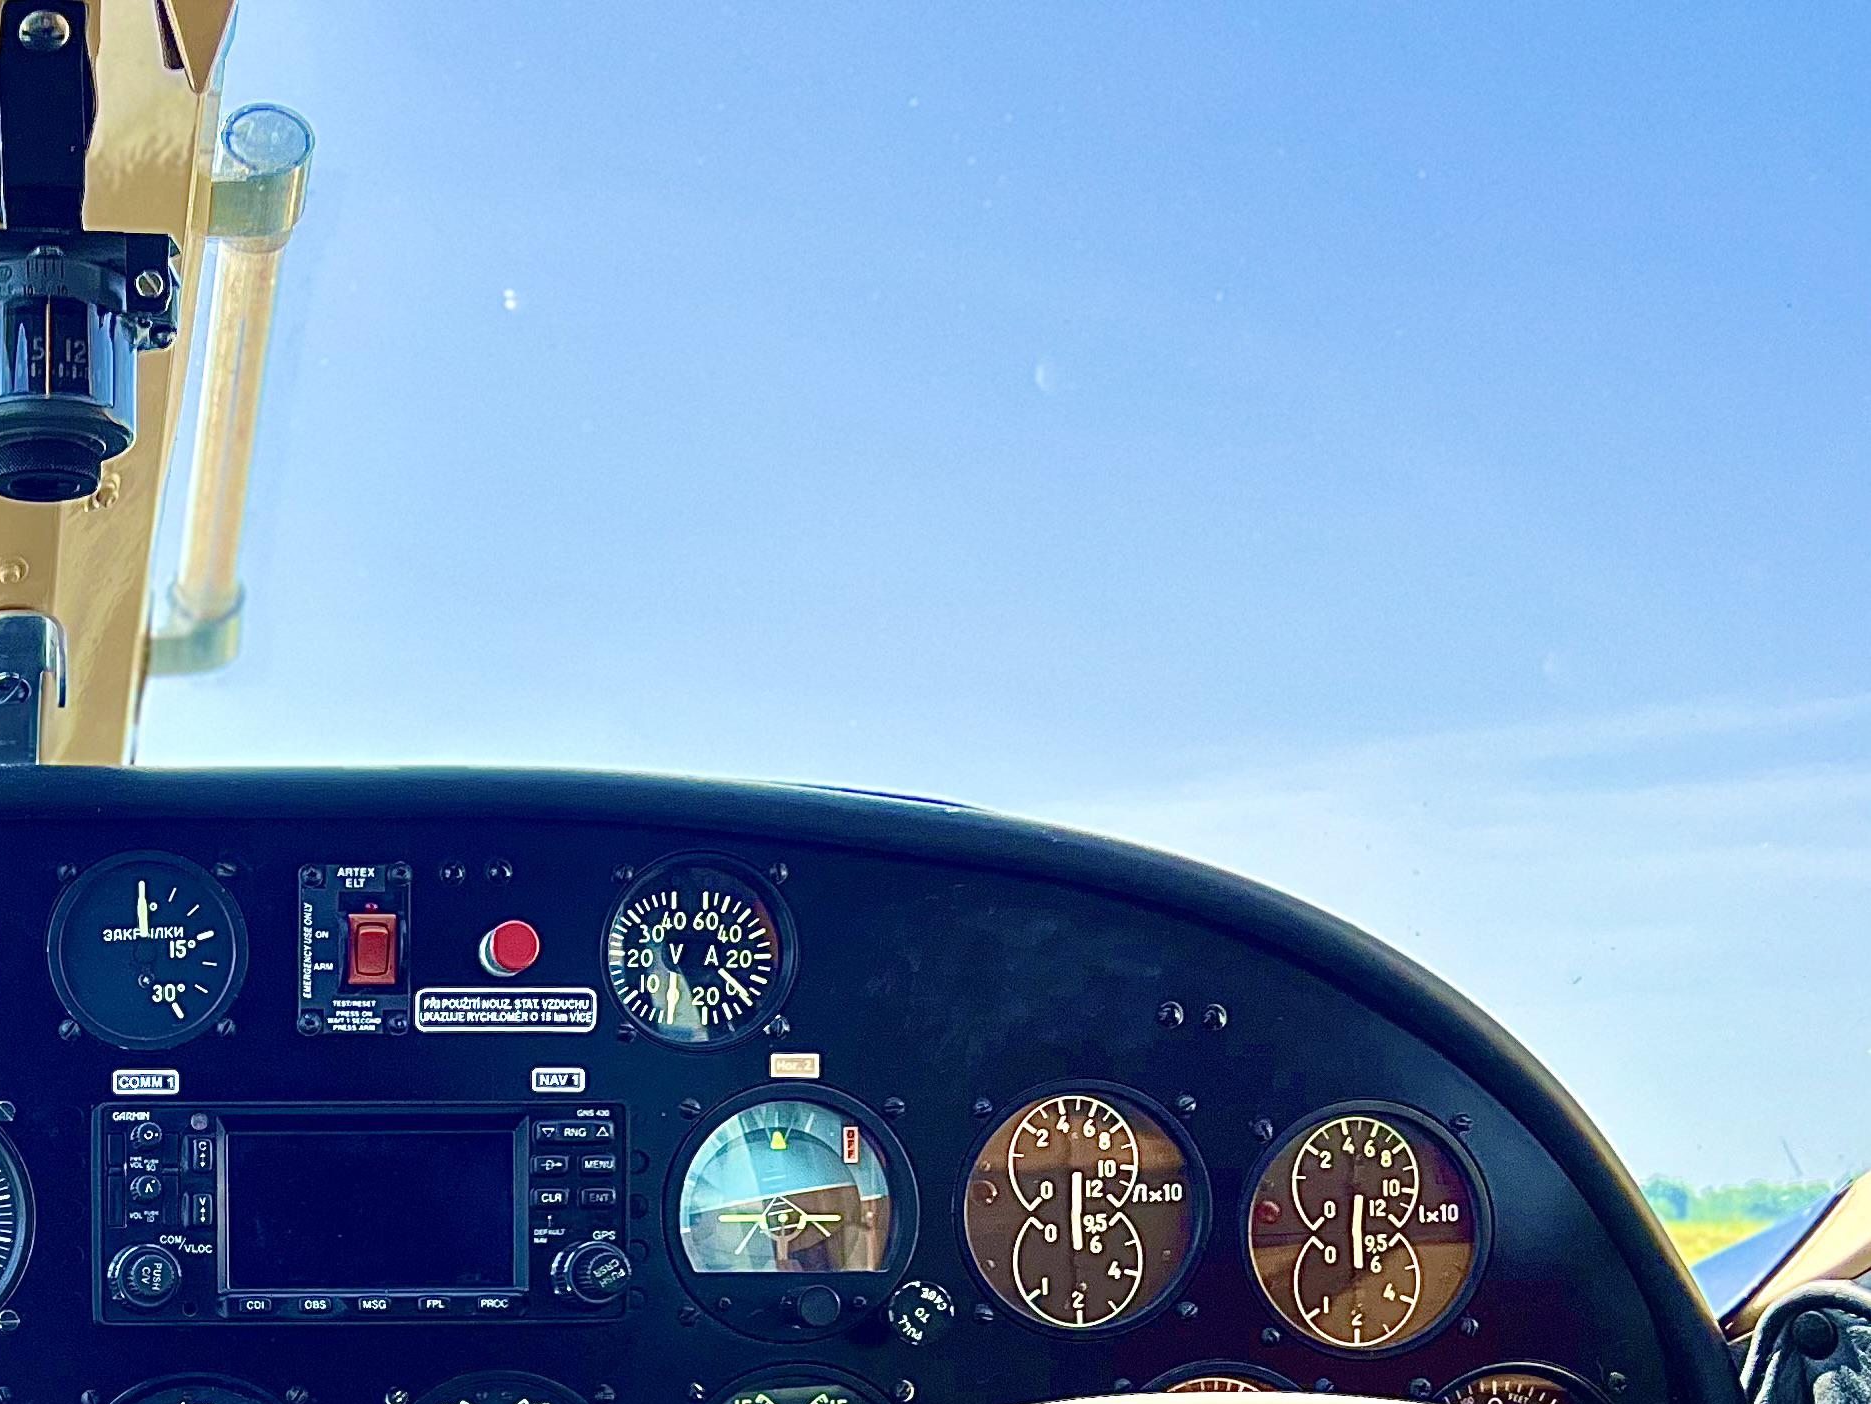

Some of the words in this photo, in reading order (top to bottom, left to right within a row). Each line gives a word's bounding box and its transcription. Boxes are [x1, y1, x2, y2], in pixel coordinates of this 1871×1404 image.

[336, 867, 376, 879] ARTEX
[345, 878, 366, 889] ELT
[660, 910, 688, 931] 40
[692, 911, 719, 931] 60
[314, 930, 329, 940] ON
[638, 923, 665, 944] 30
[716, 923, 743, 944] 40
[626, 949, 654, 968] 20
[703, 945, 720, 967] A
[725, 950, 753, 969] 20
[313, 962, 334, 972] ARM
[638, 973, 660, 994] 10
[118, 1075, 163, 1089] COMM
[166, 1076, 175, 1089] 1
[539, 1074, 569, 1086] NAV
[571, 1074, 580, 1086] 1
[563, 1127, 588, 1137] RNG
[584, 1159, 615, 1170] MENU
[1097, 1159, 1117, 1178] 10
[1085, 1179, 1104, 1199] 12
[1382, 1178, 1401, 1198] 10
[540, 1192, 563, 1203] CLR
[1368, 1198, 1387, 1217] 12
[592, 1230, 616, 1241] GPS
[246, 1300, 266, 1310] CDI
[303, 1300, 327, 1310] OBS
[362, 1299, 387, 1310] MSG
[426, 1299, 445, 1310] FPL
[479, 1299, 509, 1309] PROC
